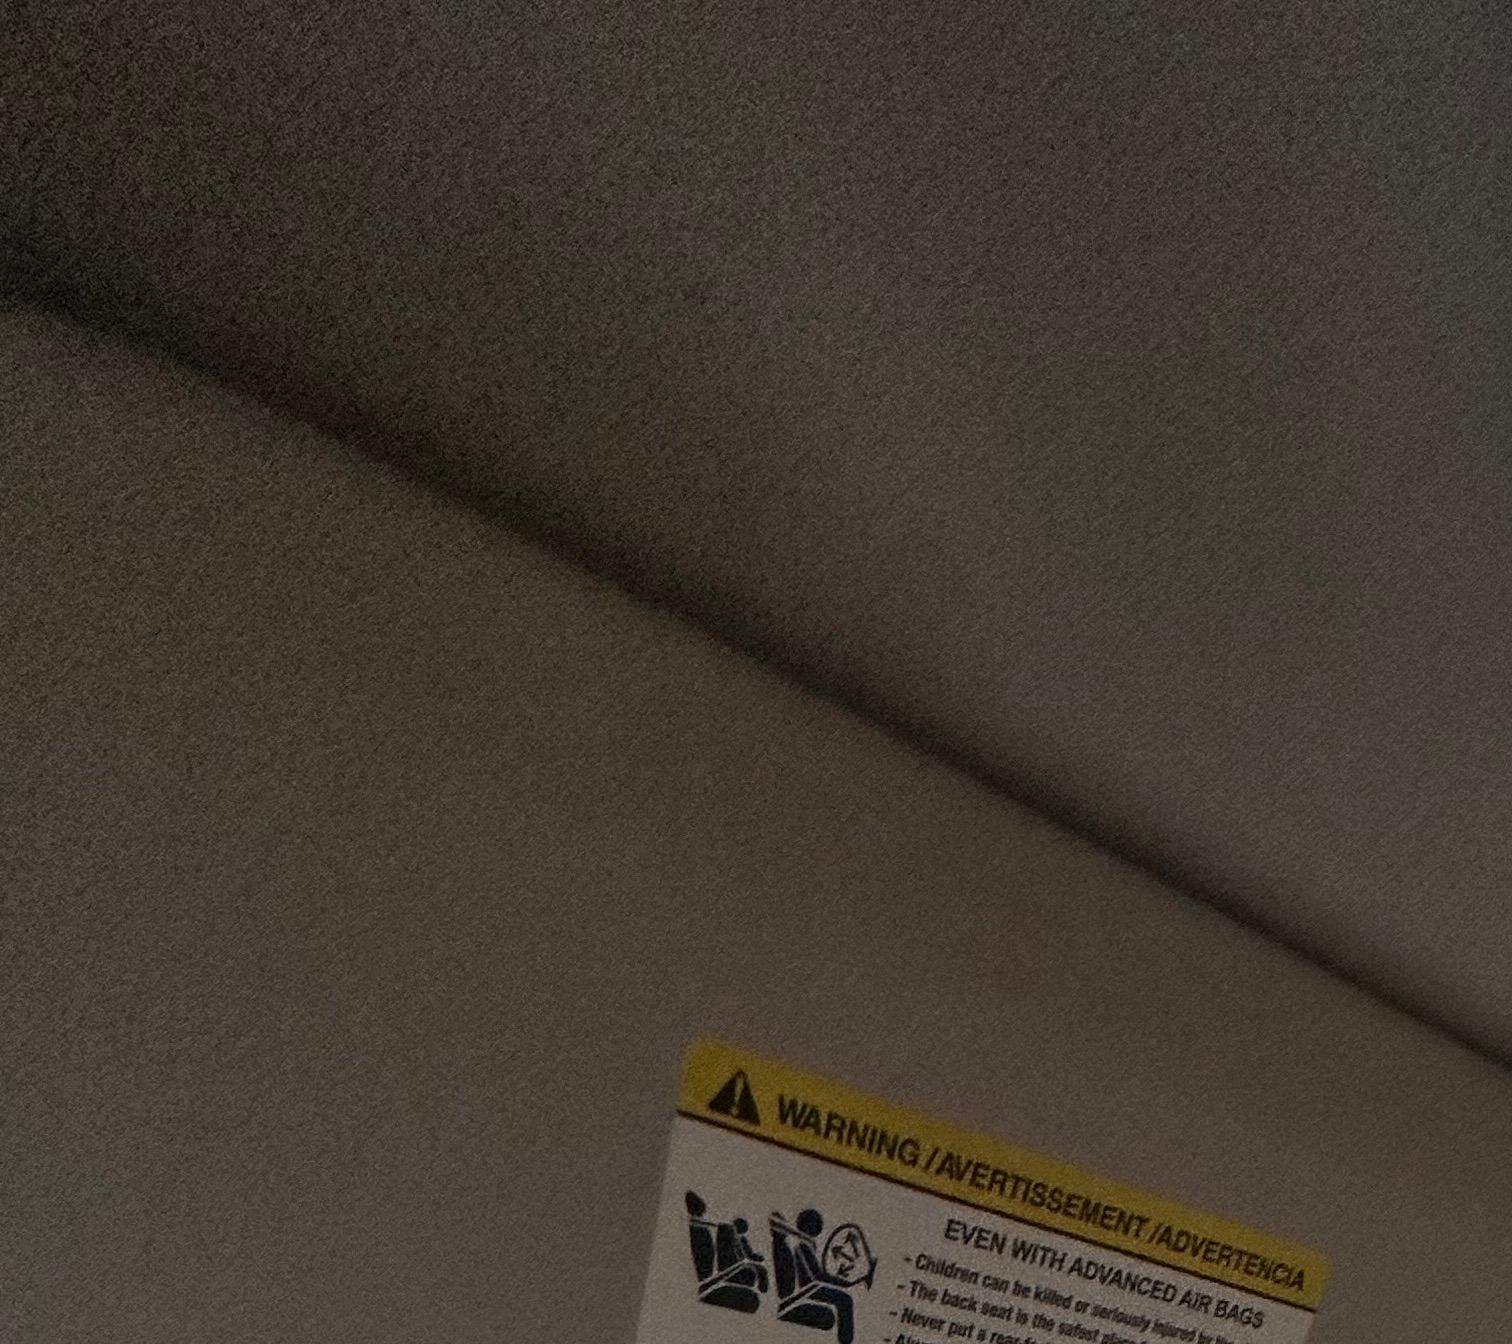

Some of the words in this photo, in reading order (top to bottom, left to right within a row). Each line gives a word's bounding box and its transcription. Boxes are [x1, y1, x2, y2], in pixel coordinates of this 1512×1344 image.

[777, 1095, 920, 1166] WARNING
[925, 1147, 1148, 1237] /AVERTISSEMENT
[1149, 1223, 1304, 1291] /ADVERTENCIA
[910, 1279, 937, 1299] The
[915, 1253, 979, 1283] Children
[982, 1274, 1009, 1292] can
[944, 1218, 1006, 1254] EVEN
[1011, 1238, 1067, 1271] WITH
[1068, 1258, 1176, 1302] ADVANCED
[1178, 1289, 1212, 1313] AIR
[1214, 1299, 1264, 1328] BAGS
[900, 1307, 945, 1330] Never
